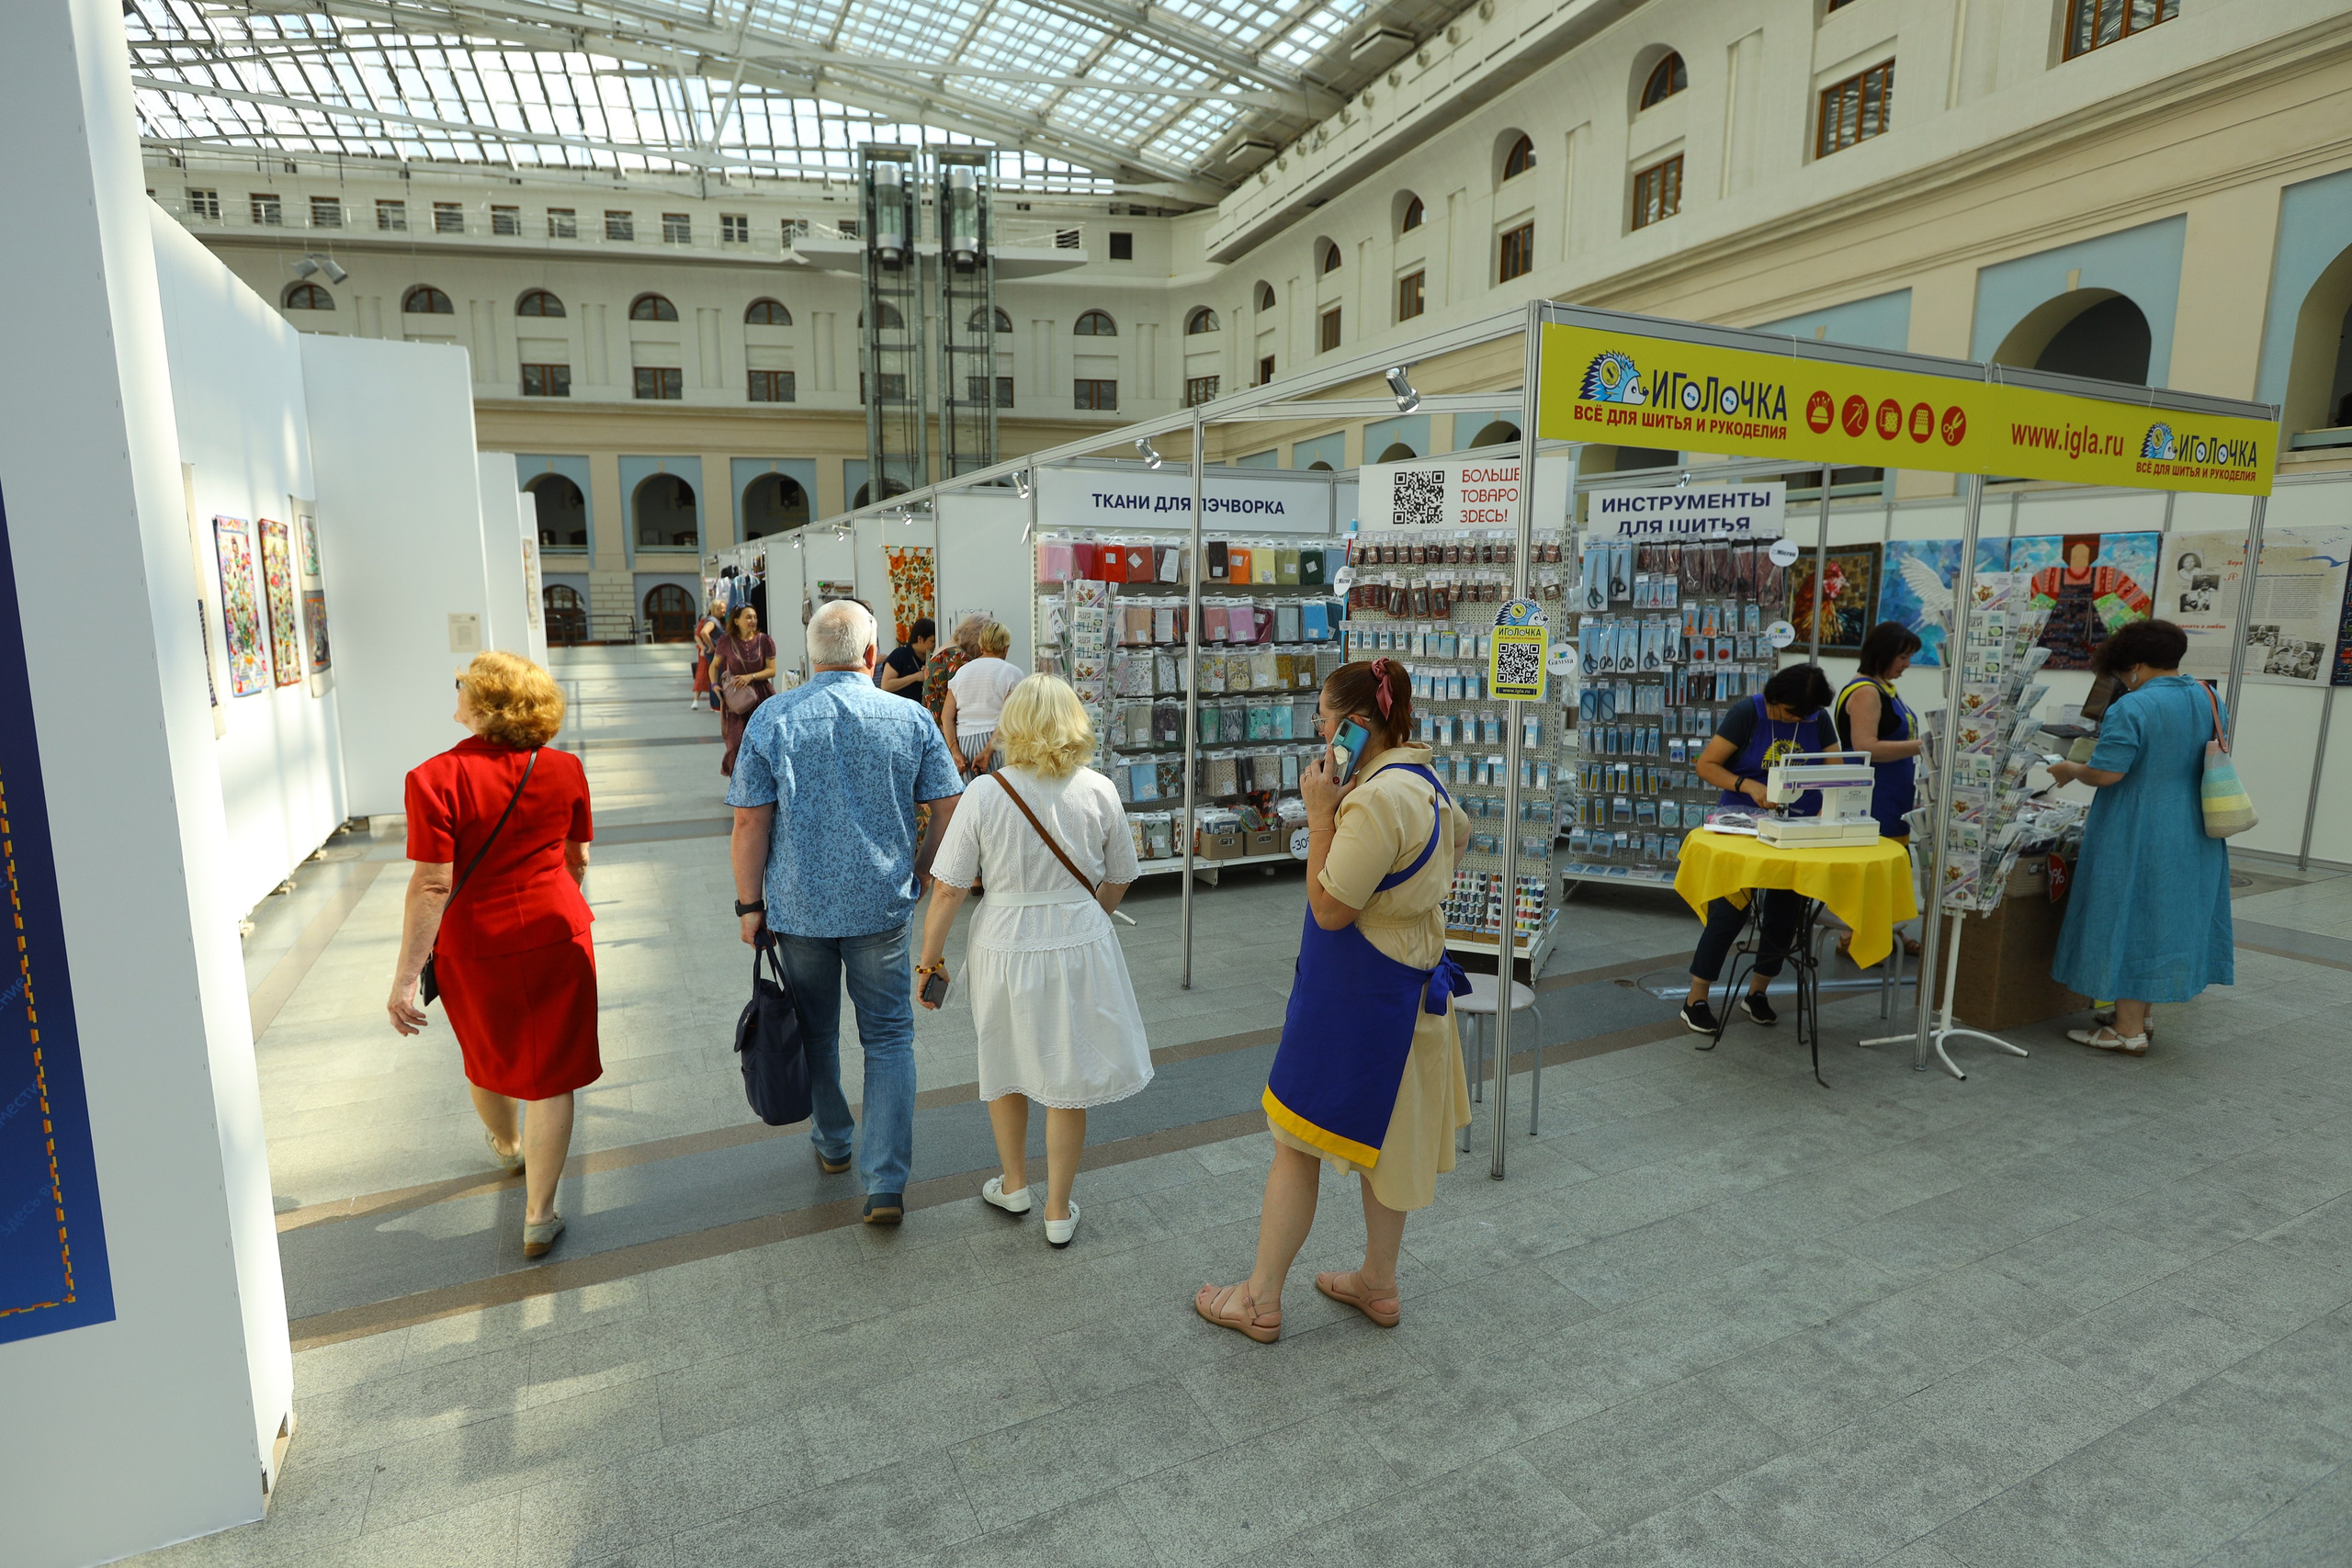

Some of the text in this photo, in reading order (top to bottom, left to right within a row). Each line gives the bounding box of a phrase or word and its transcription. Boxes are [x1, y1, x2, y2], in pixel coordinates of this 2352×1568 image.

[1574, 404, 1787, 440] ВСЁ ДЛЯ ШИТЬЯ И РУКОДЕЛИЯ
[2011, 423, 2124, 459] www.igla.ru
[1462, 467, 1520, 482] БОЛЬШЕ
[2136, 461, 2256, 482] ВСЁ ДЛЯ ШИТЬЯ И РУКОДЕЛИЯ
[1091, 493, 1150, 510] ТКАНИ
[1154, 496, 1192, 513] ДЛЯ
[1461, 488, 1519, 502] ТОВАРО
[1601, 491, 1770, 513] ИНСТРУМЕНТЫ
[1618, 517, 1750, 537] ДЛЯ ШИТЬЯ
